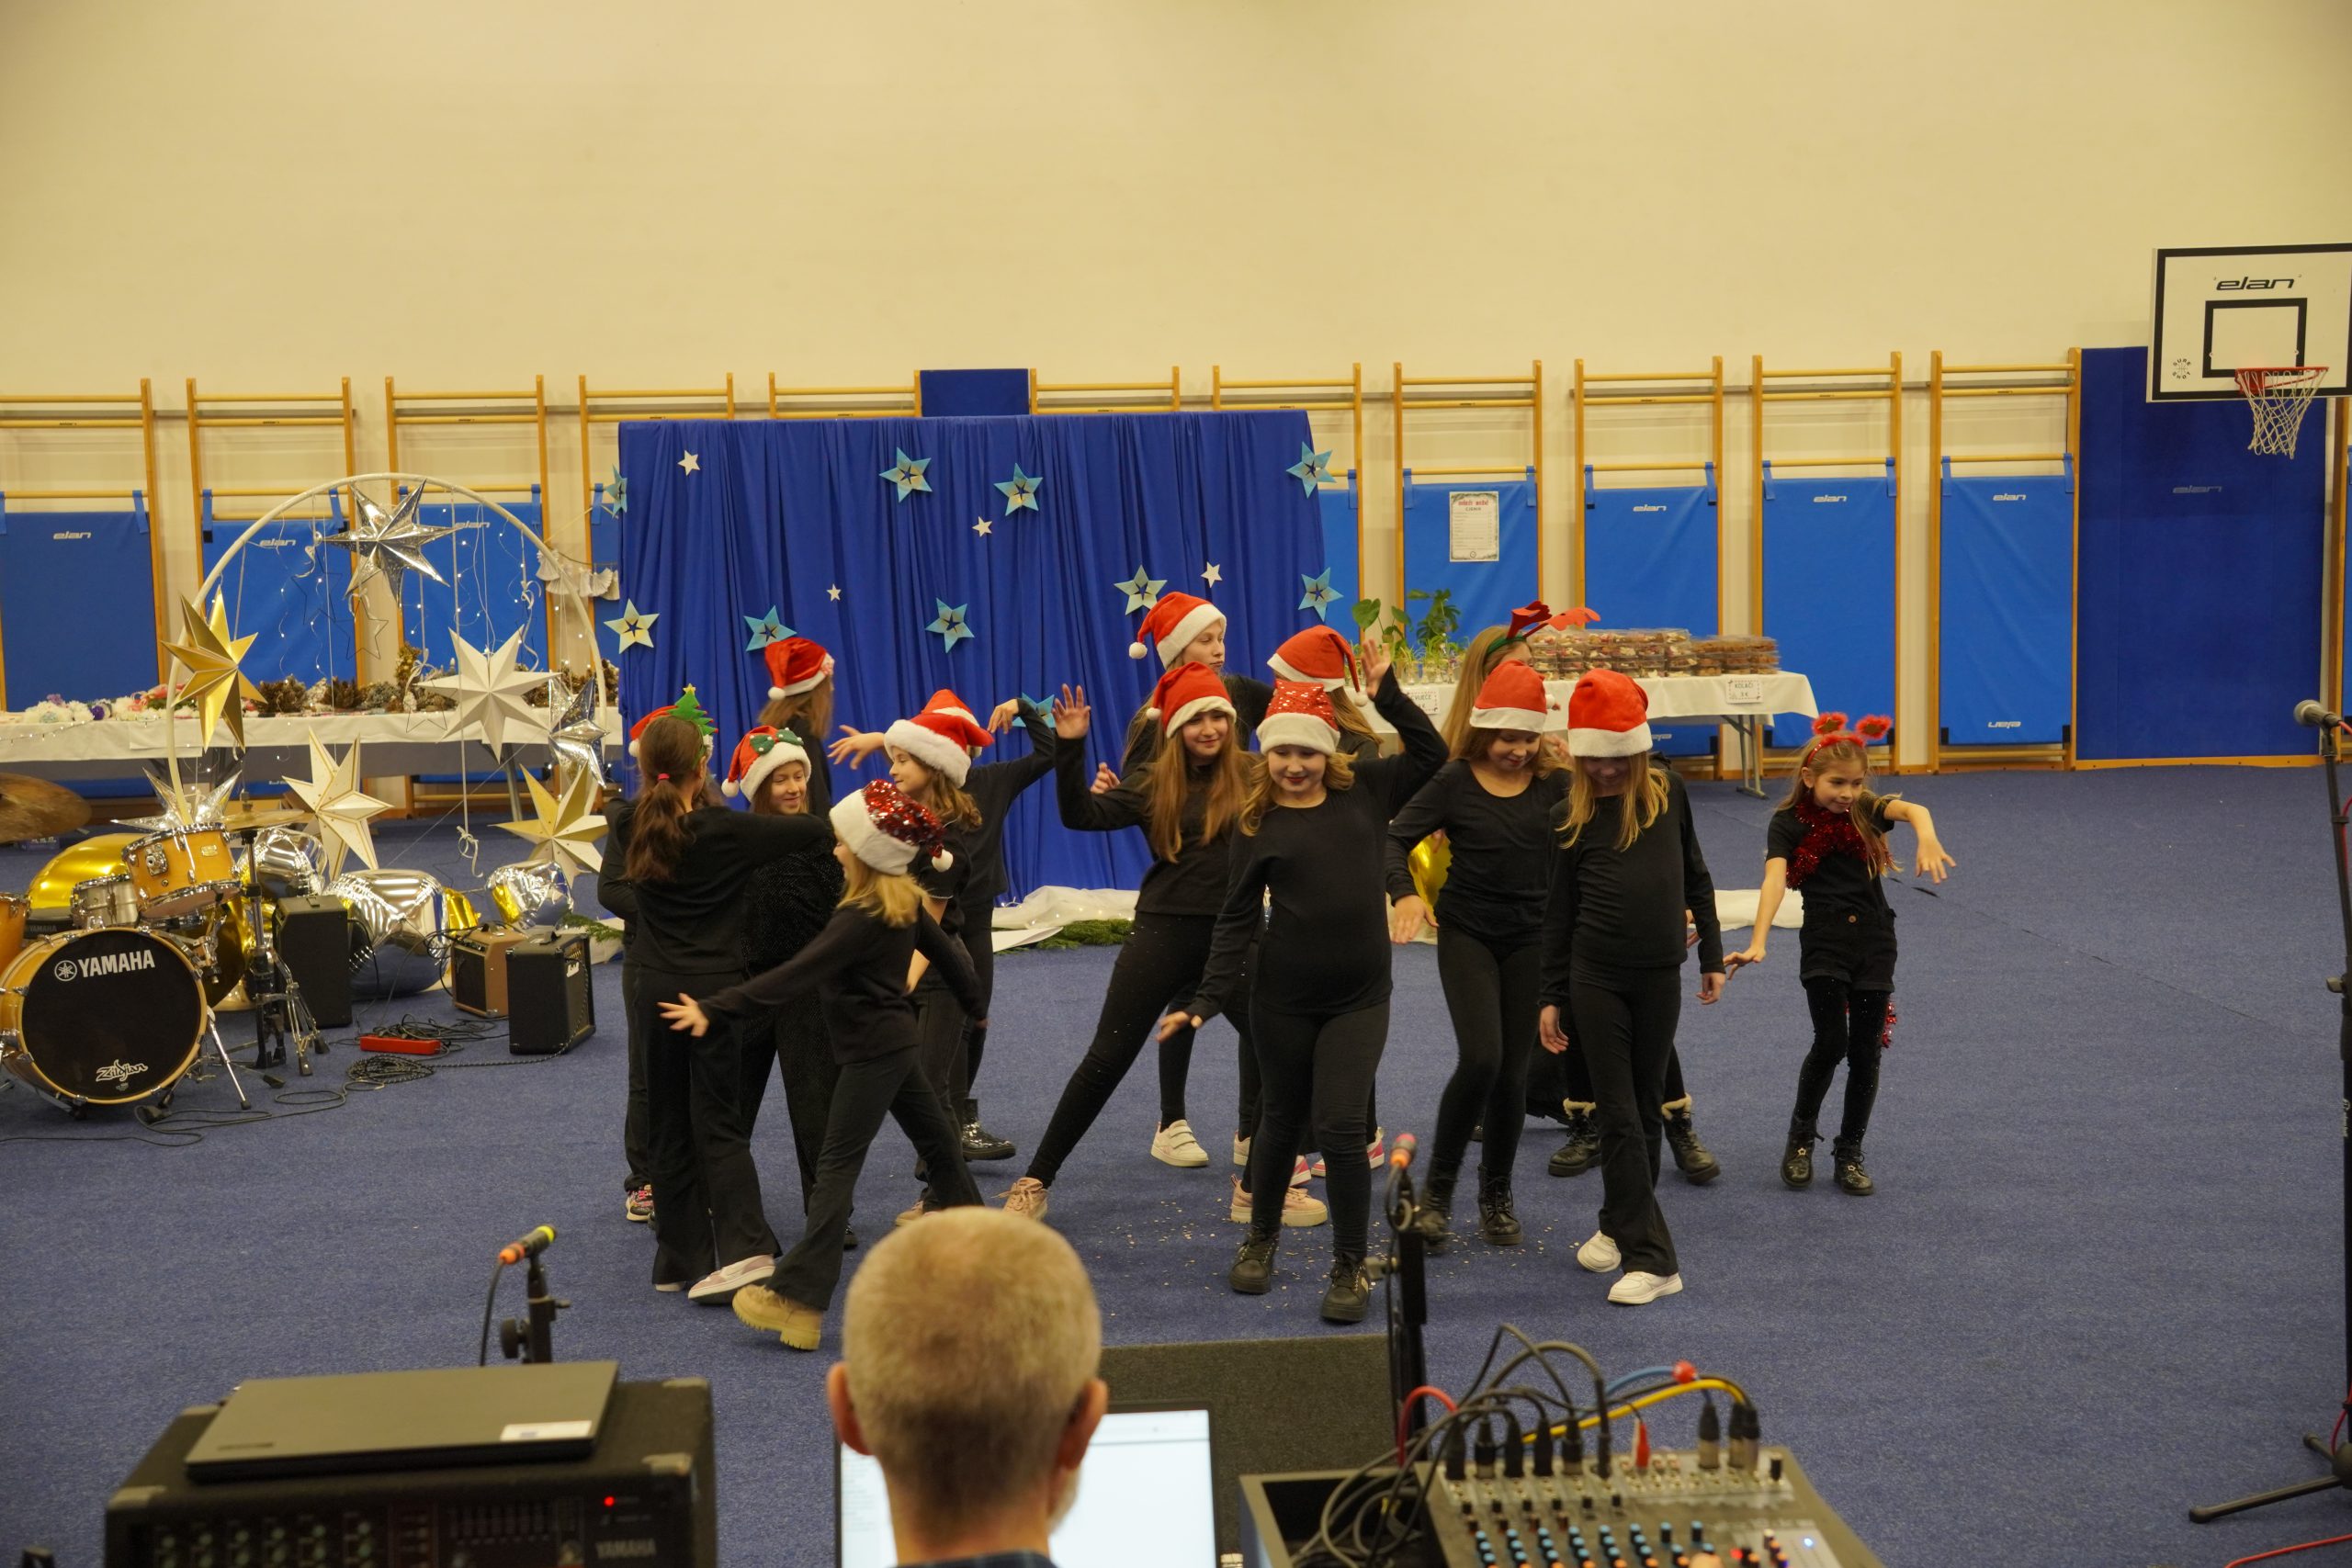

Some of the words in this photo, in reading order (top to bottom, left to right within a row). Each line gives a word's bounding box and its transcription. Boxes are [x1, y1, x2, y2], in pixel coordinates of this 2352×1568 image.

[2216, 276, 2295, 291] elan
[2173, 485, 2223, 494] elan
[1814, 494, 1848, 502] elan
[1993, 493, 2027, 502] elan
[1633, 504, 1667, 513] elan
[53, 531, 92, 540] elan
[259, 538, 297, 547] elan
[77, 949, 156, 978] YAMAHA
[96, 1059, 149, 1082] Zildjian
